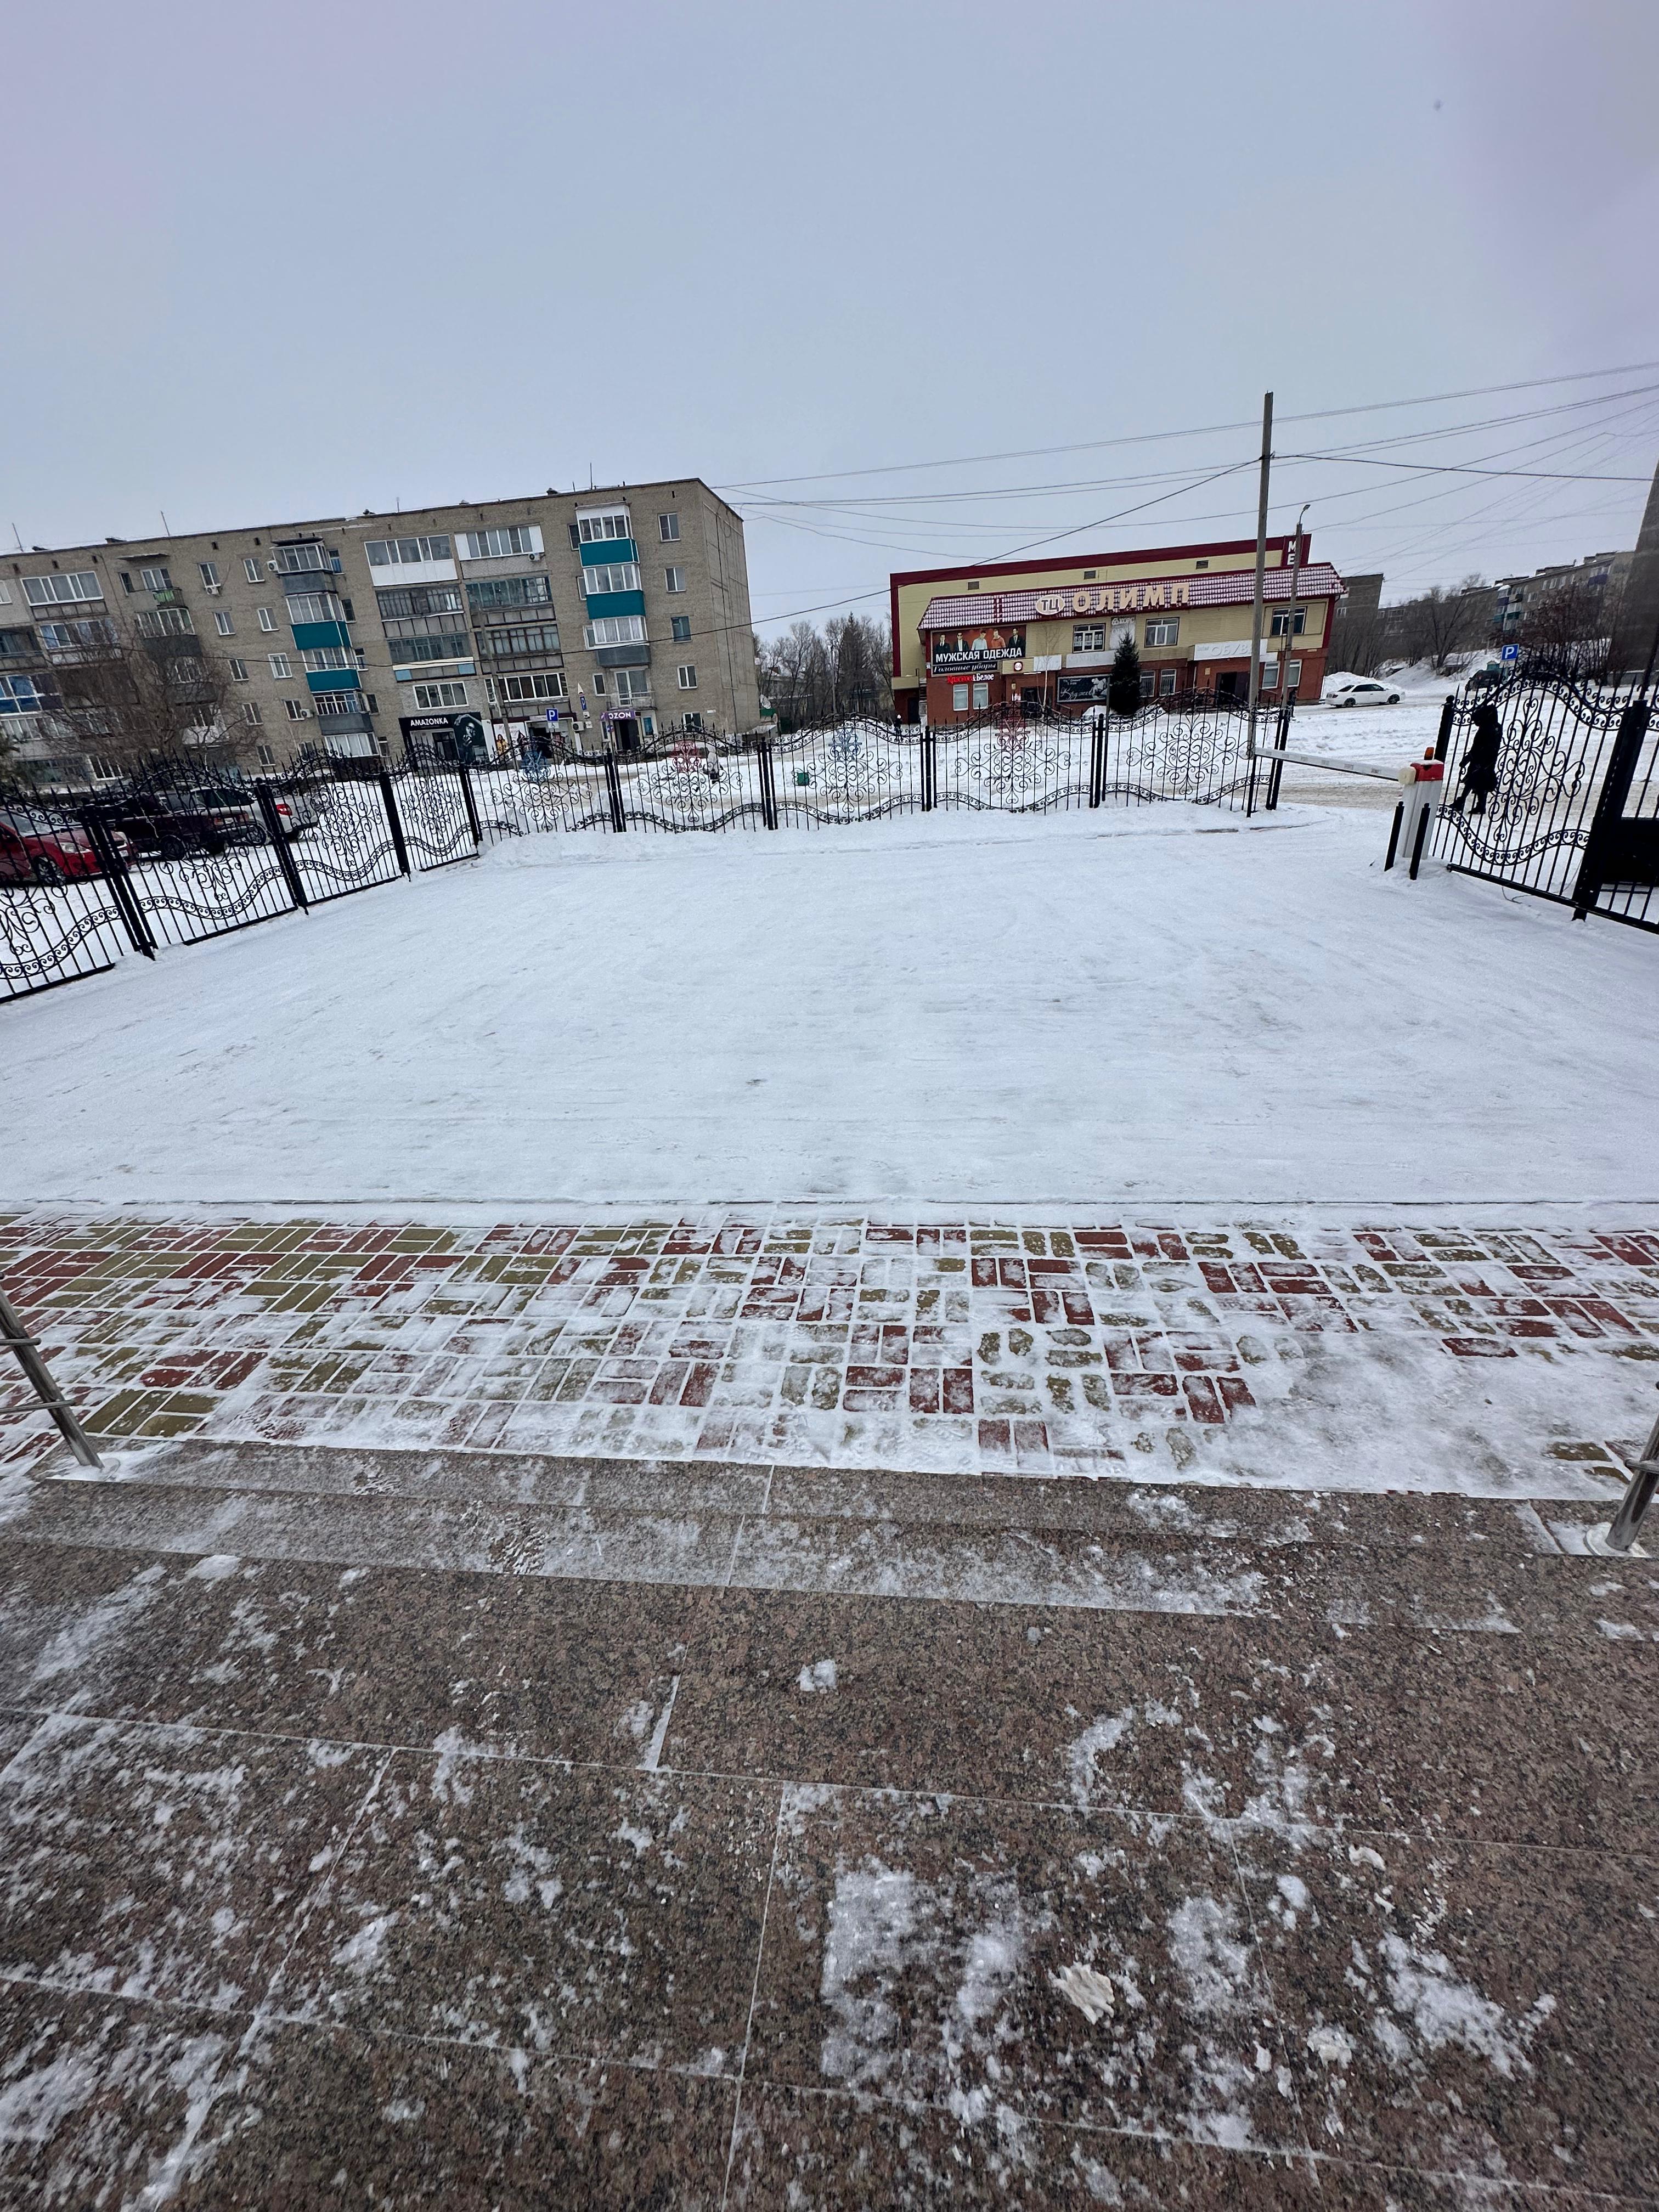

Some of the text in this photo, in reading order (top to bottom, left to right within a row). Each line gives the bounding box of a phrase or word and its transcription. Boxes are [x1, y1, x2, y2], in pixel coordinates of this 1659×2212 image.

[1041, 582, 1189, 612] ТЦ ОЛИМП
[935, 647, 1022, 663] МУЖСКАЯ ОДЕЖДА
[1505, 646, 1515, 658] P
[972, 663, 996, 671] уборы
[549, 710, 556, 720] P
[410, 717, 449, 726] AMAZONKA
